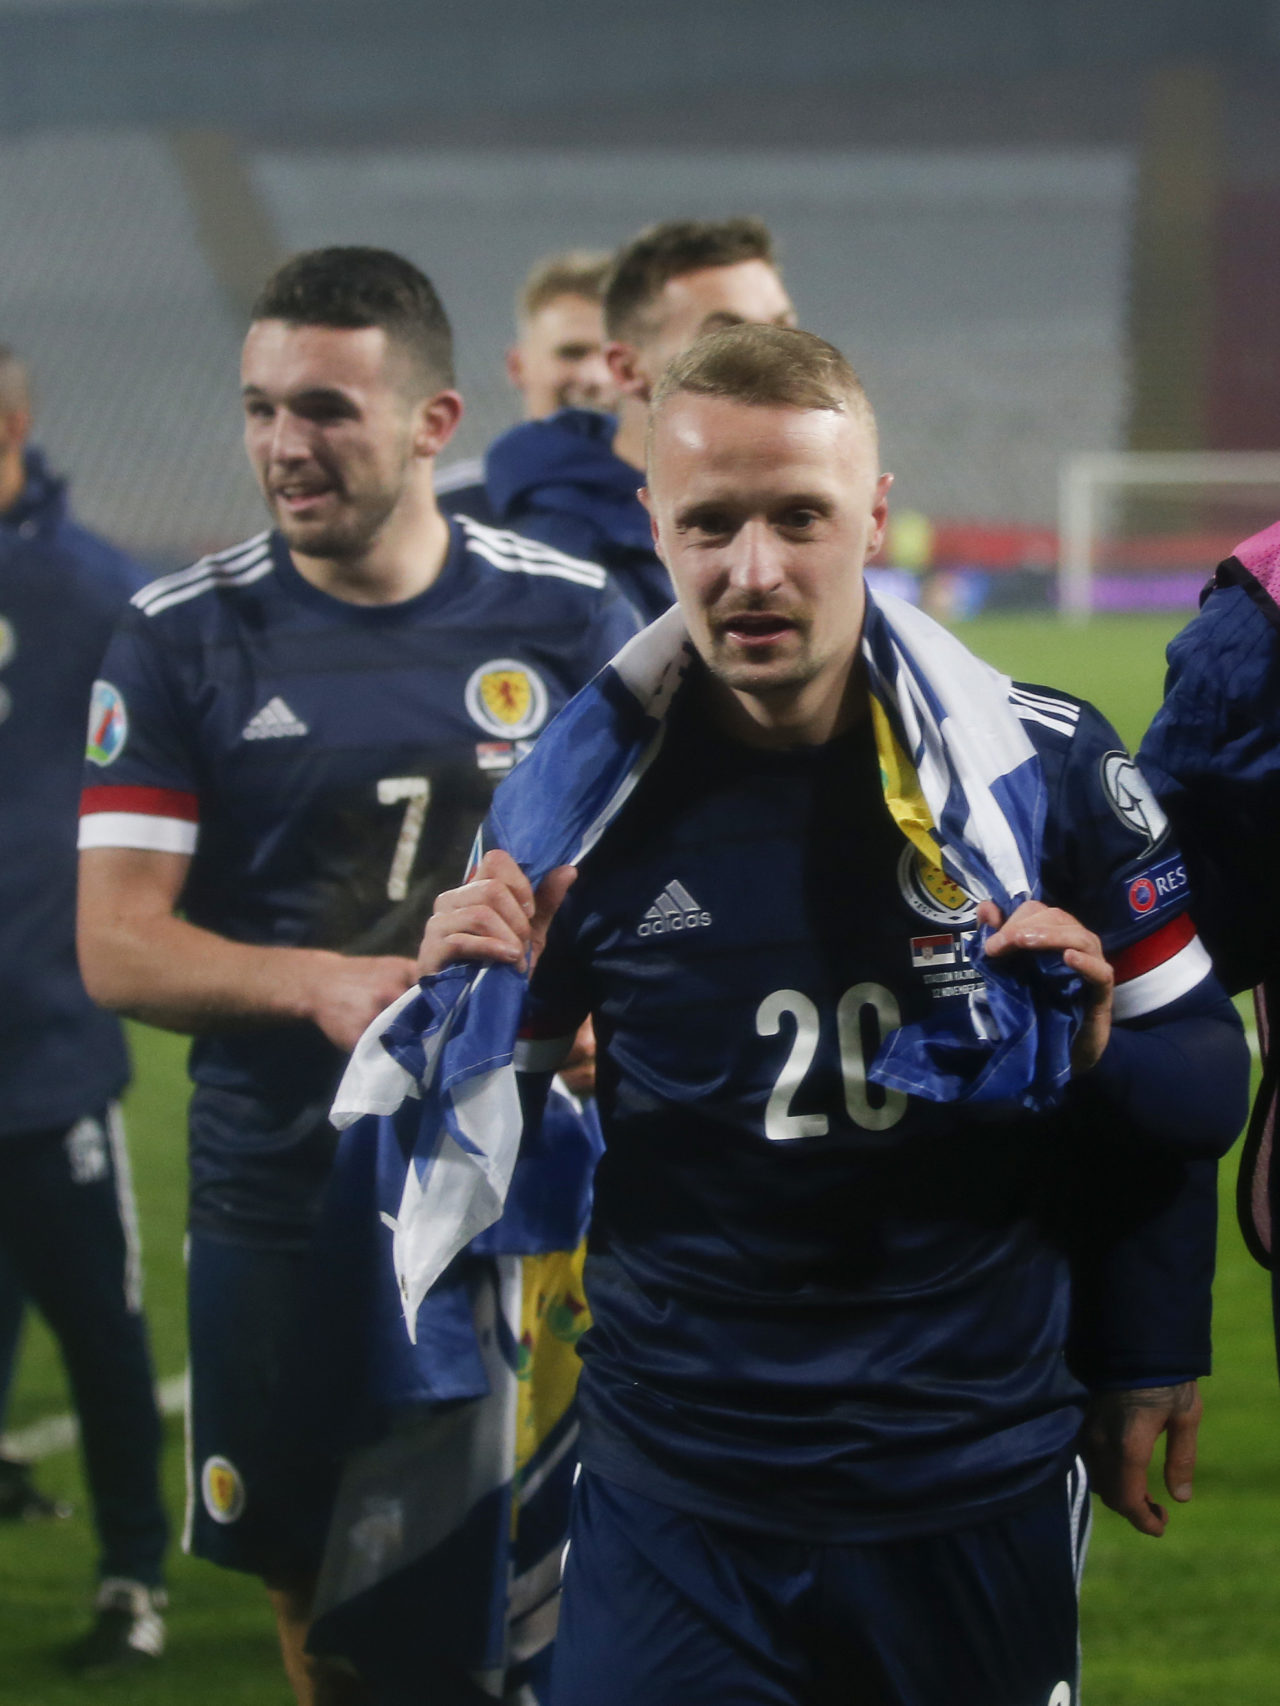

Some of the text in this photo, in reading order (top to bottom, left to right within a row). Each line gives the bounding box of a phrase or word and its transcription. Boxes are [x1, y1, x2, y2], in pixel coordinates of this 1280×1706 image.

[376, 776, 430, 901] 7
[1154, 866, 1188, 896] RES
[637, 911, 713, 937] adidas
[755, 981, 907, 1141] 20
